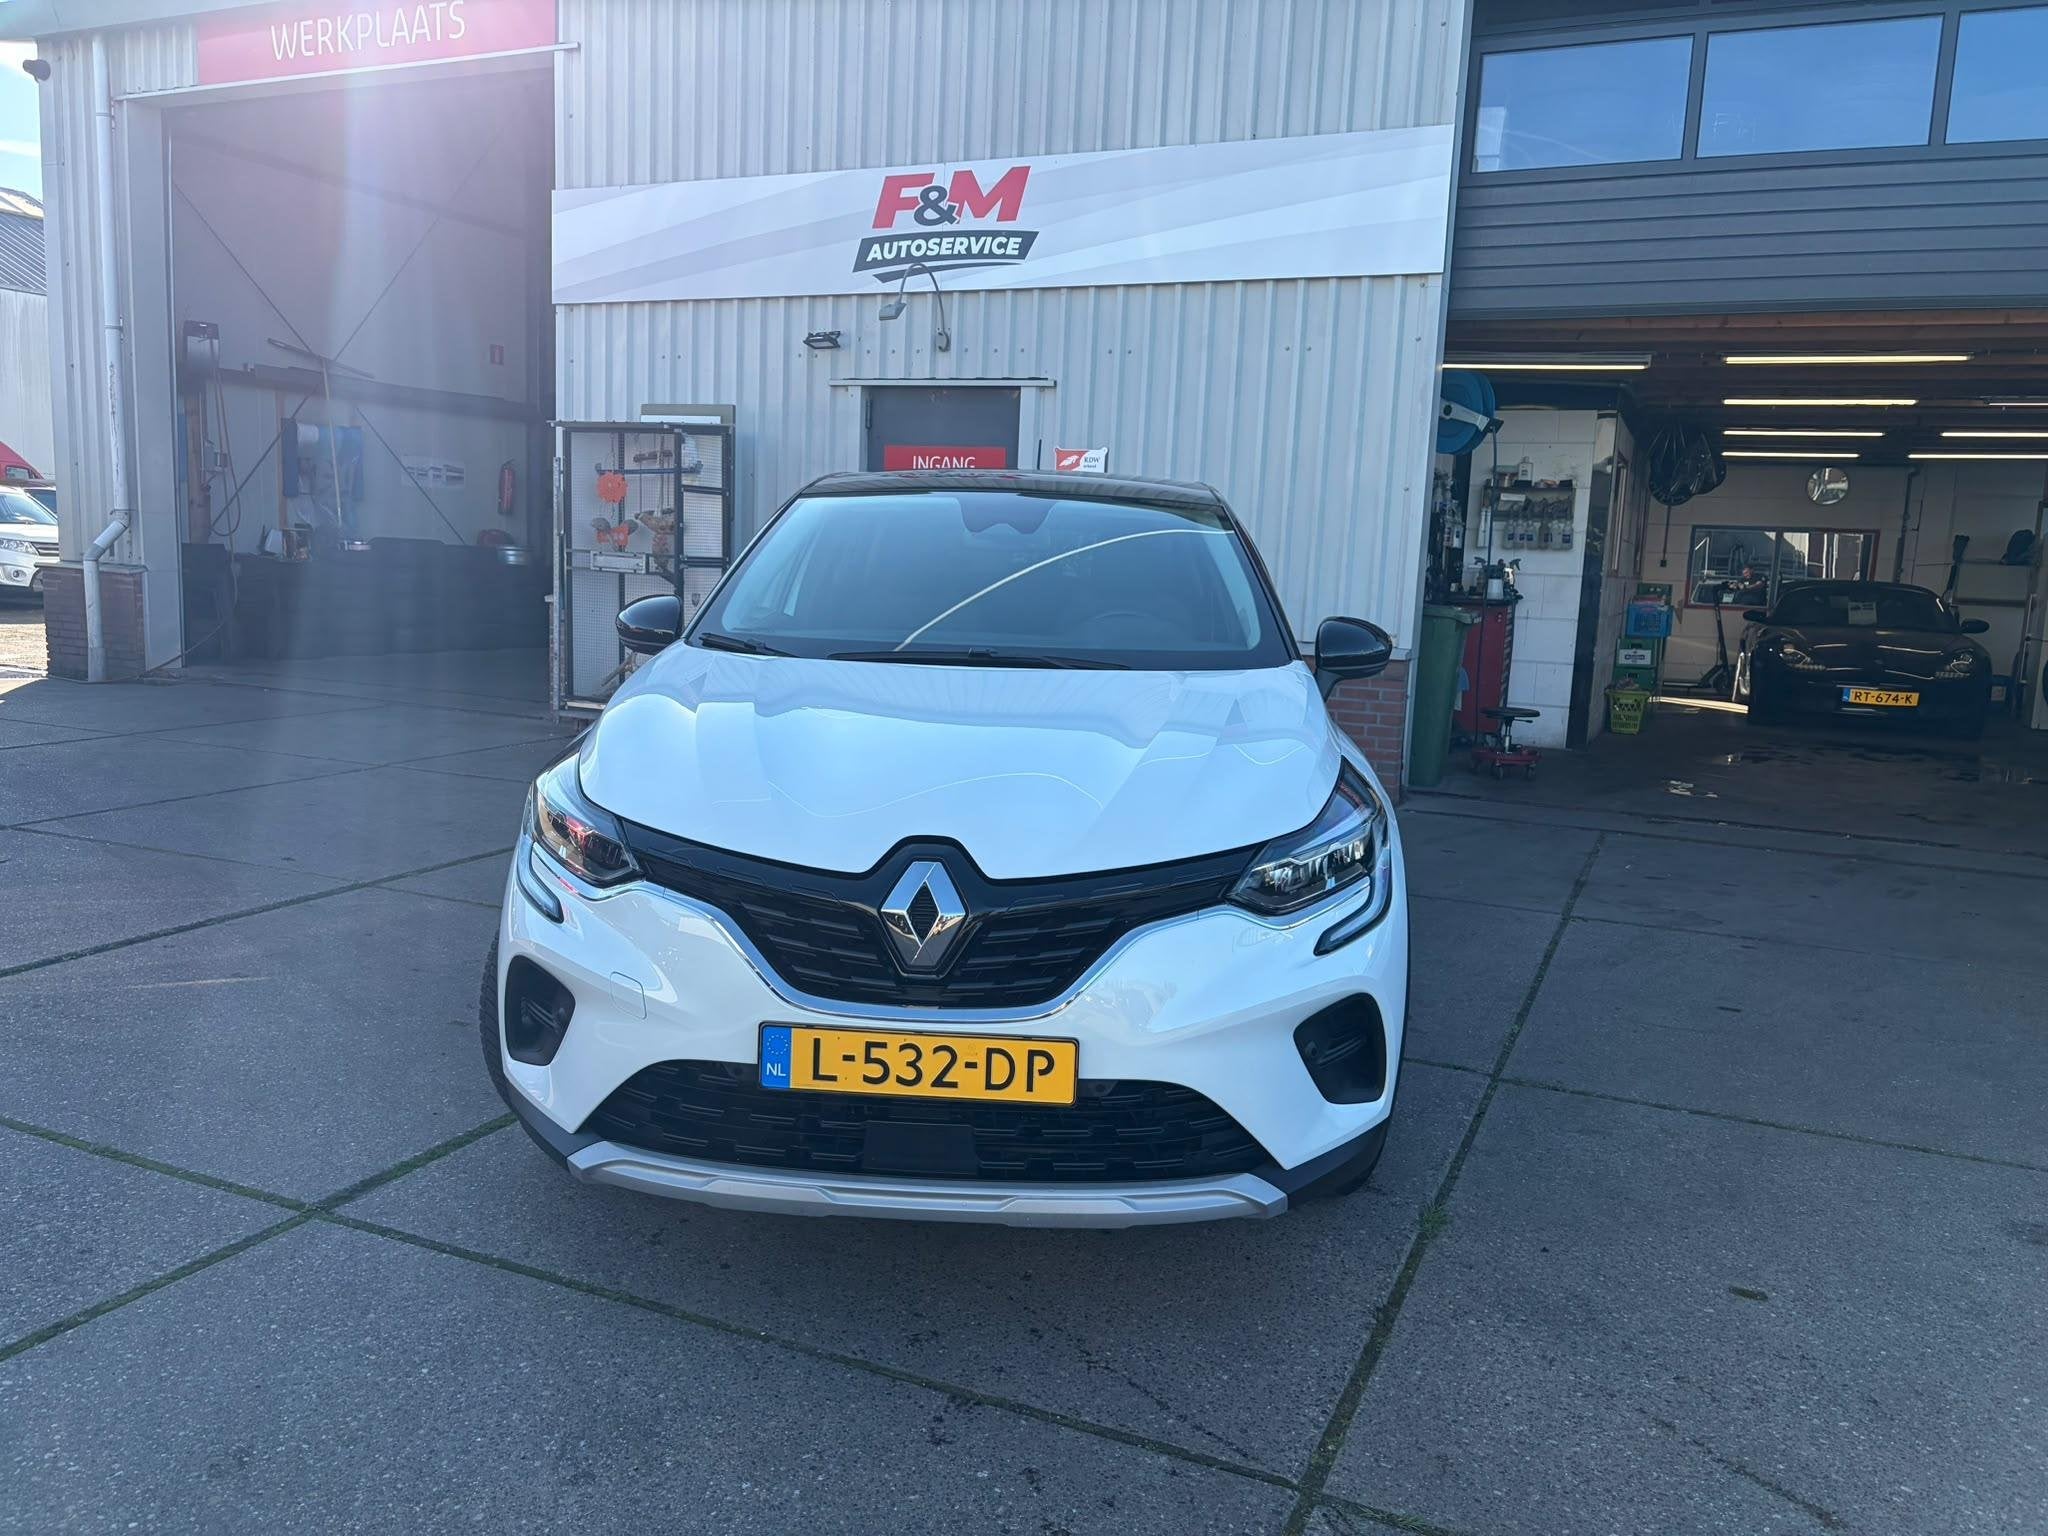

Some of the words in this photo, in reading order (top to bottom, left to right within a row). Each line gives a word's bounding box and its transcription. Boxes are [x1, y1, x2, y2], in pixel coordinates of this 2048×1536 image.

[271, 0, 466, 60] WERKPLAATS
[871, 165, 1032, 230] F&M
[866, 235, 1023, 262] AUTOSERVICE
[912, 455, 976, 469] INGANG
[1853, 691, 1913, 704] RT-674-K
[766, 1062, 787, 1077] NL
[811, 1037, 1055, 1093] L-532-DP
